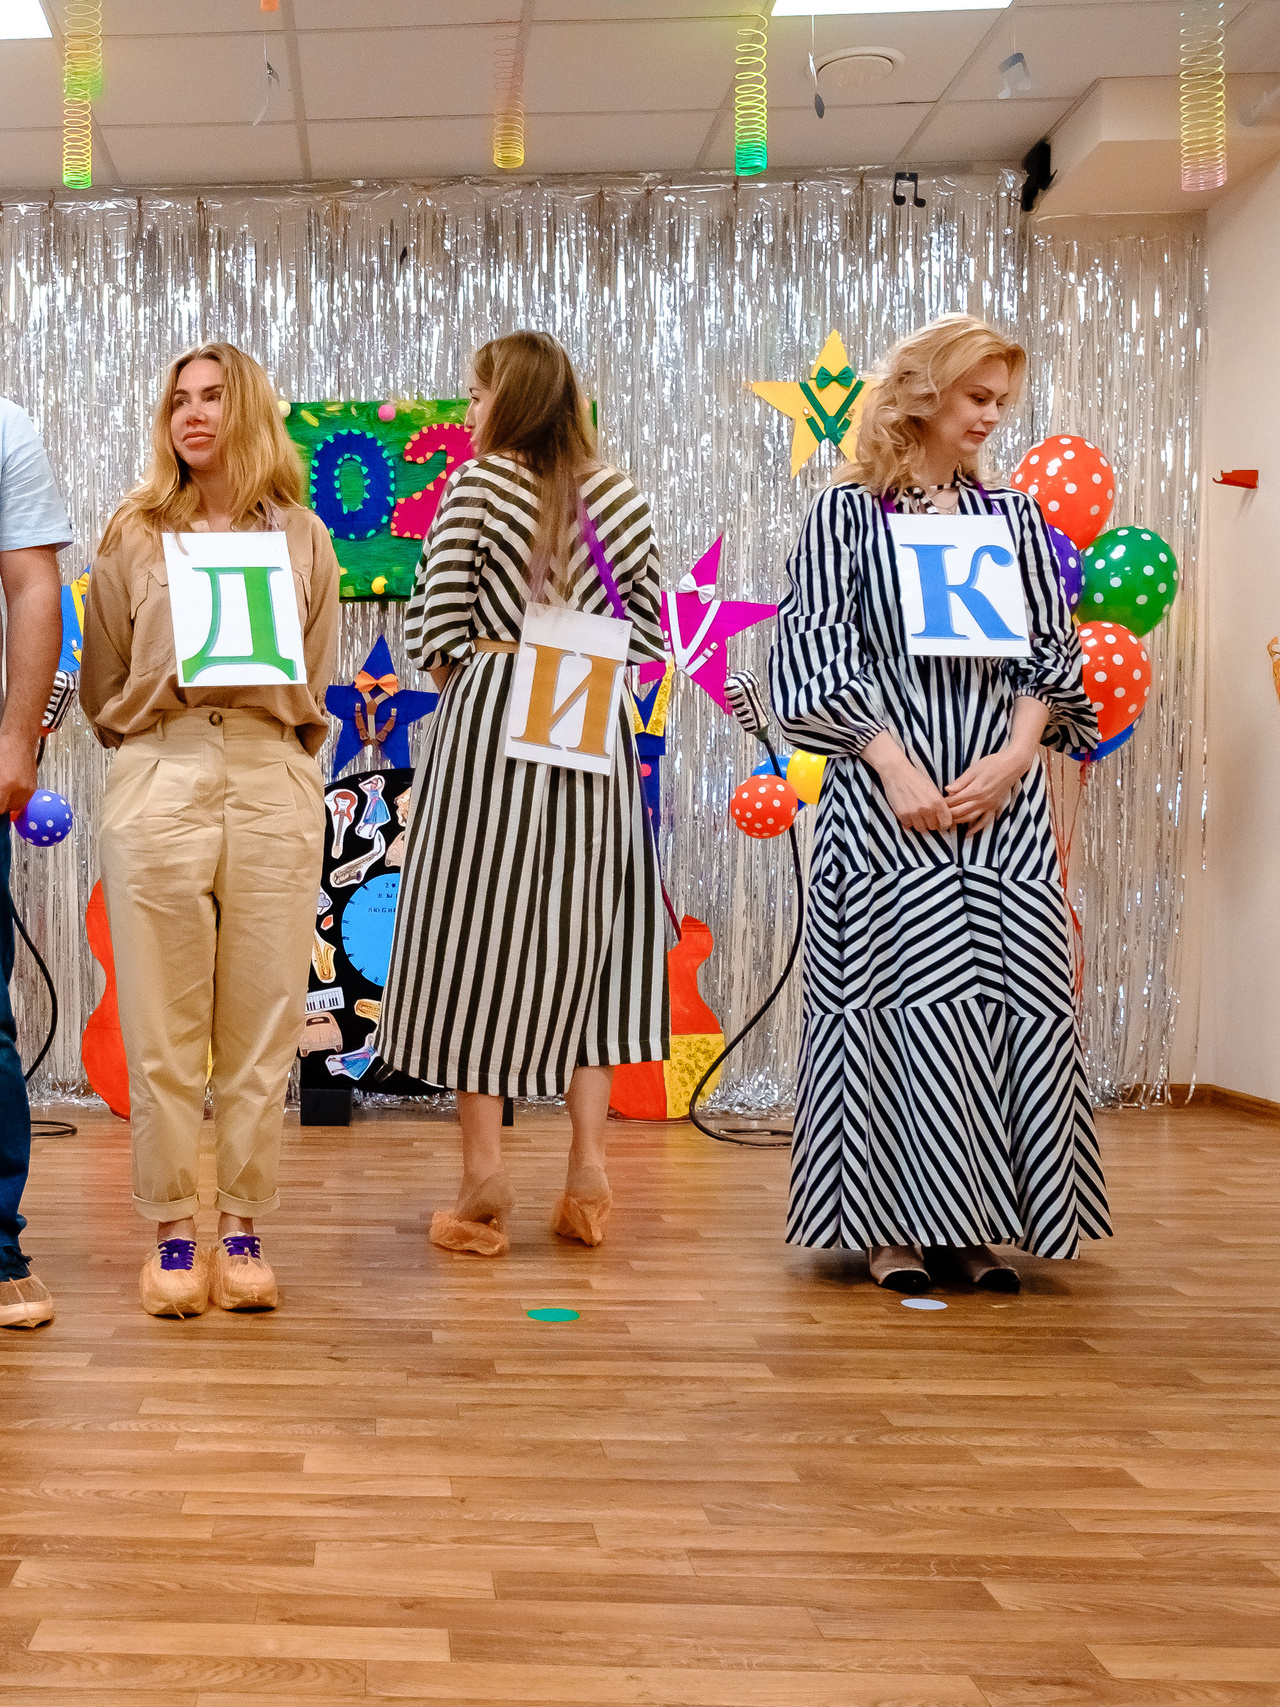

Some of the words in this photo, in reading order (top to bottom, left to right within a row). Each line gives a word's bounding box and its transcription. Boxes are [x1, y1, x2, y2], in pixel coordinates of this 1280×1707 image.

[181, 566, 298, 683] Д
[899, 543, 1027, 642] К
[510, 641, 625, 759] И
